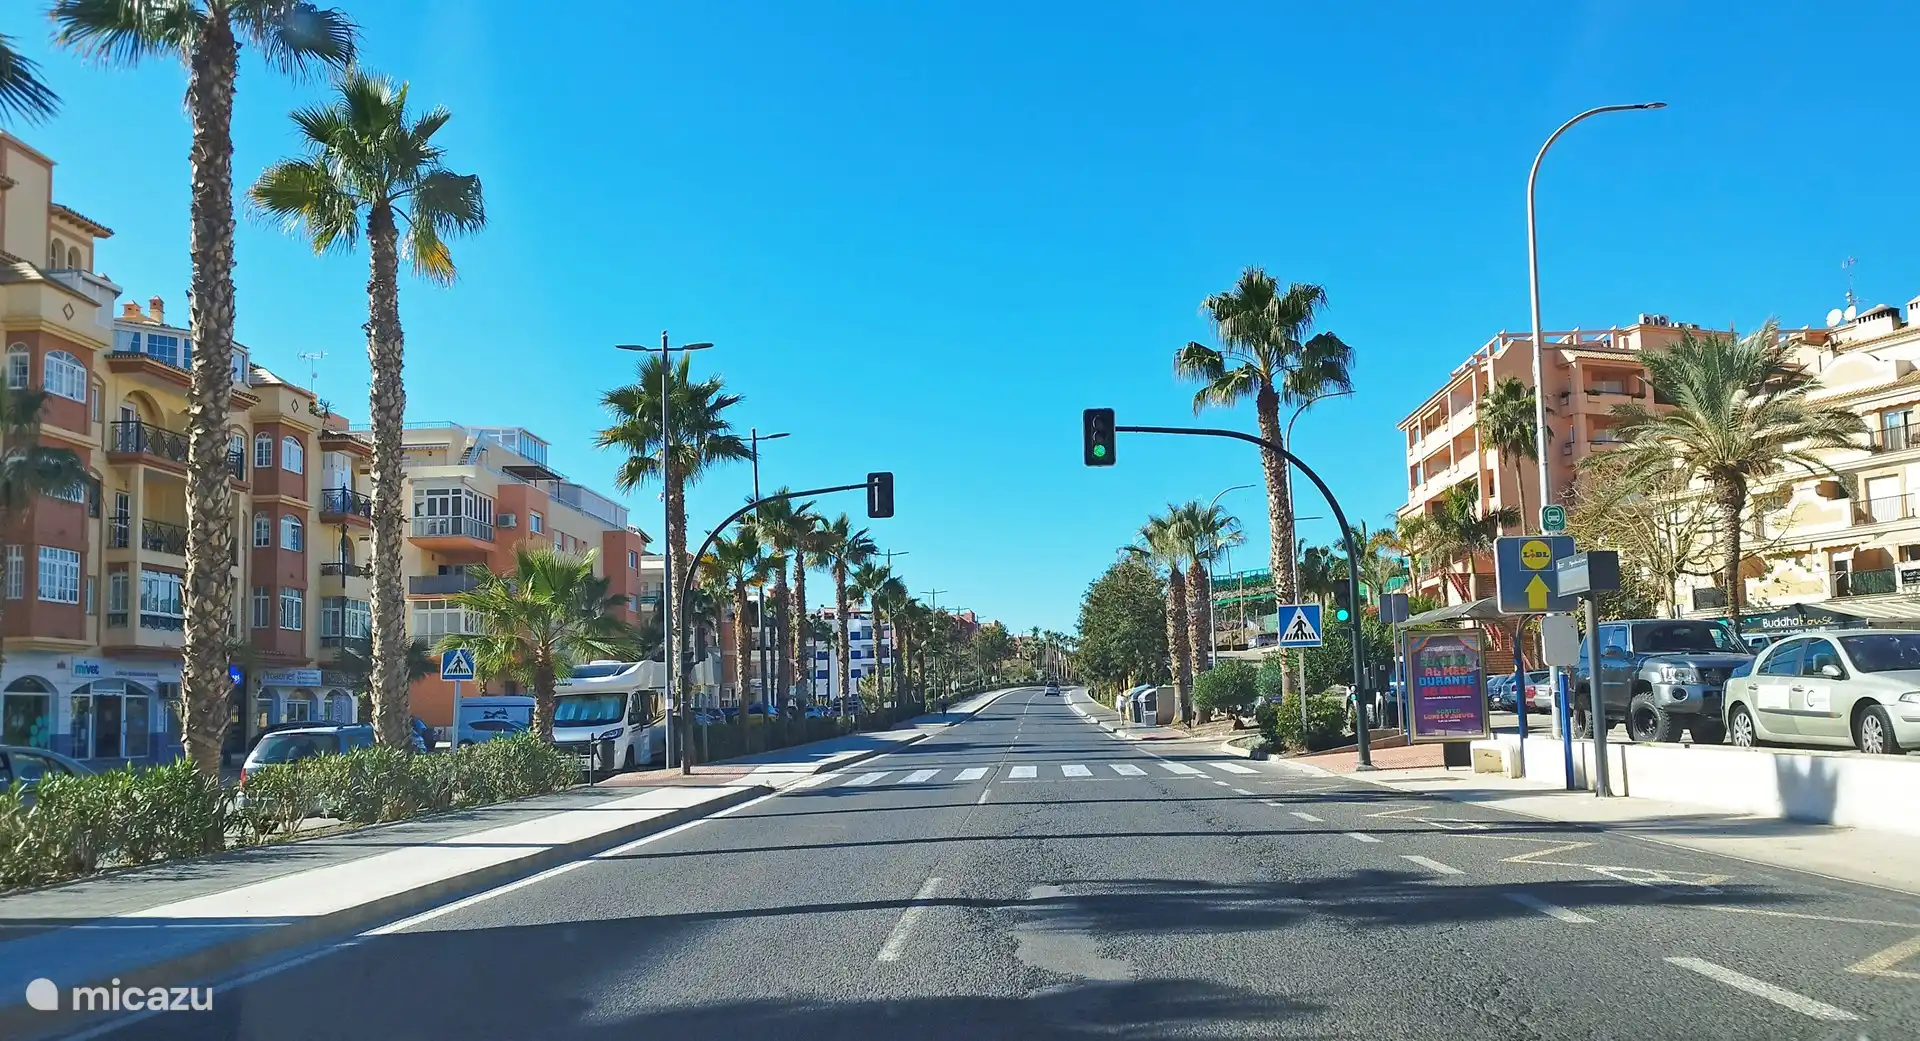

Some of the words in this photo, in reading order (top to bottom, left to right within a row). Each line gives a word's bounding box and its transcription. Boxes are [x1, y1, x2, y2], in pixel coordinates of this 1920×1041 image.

[1523, 549, 1549, 557] LIDL
[1762, 615, 1799, 628] Buddha
[1419, 676, 1474, 686] DURANTE
